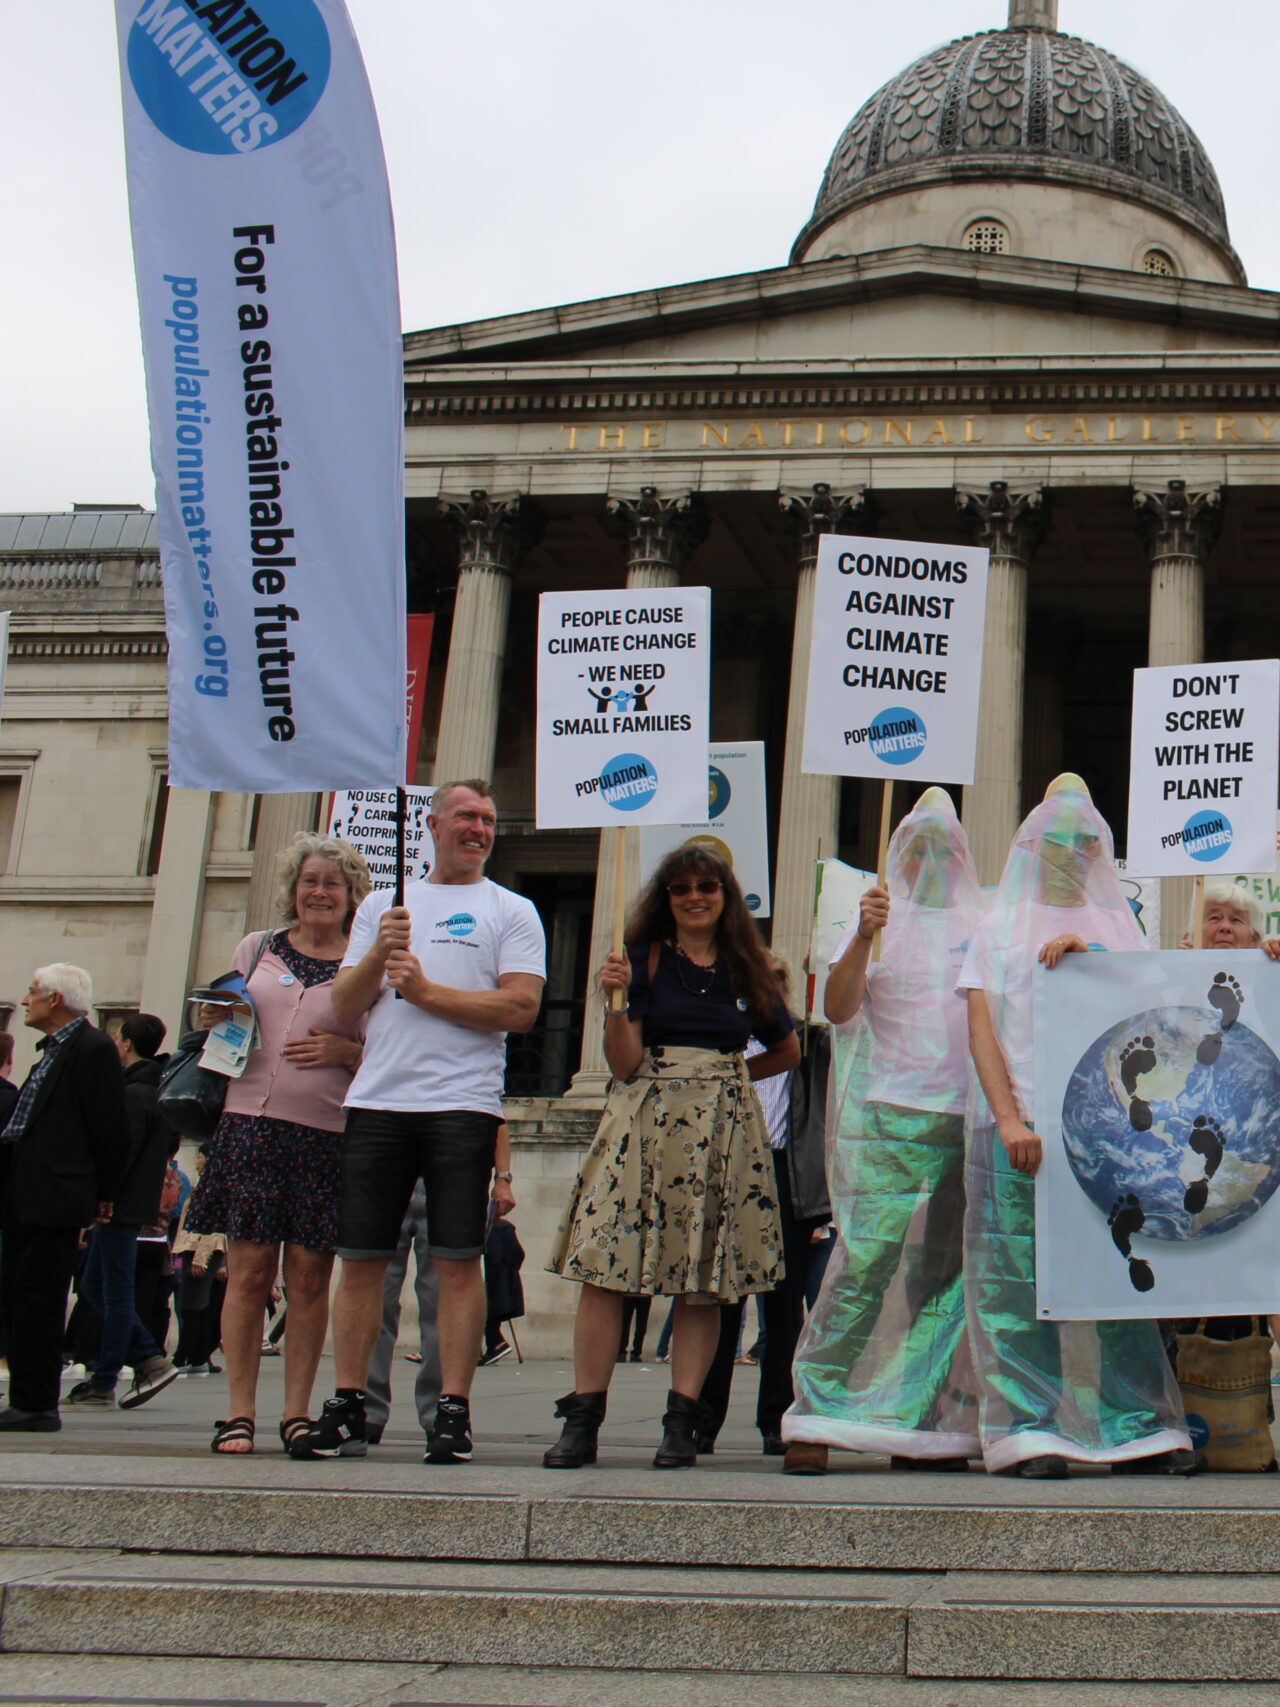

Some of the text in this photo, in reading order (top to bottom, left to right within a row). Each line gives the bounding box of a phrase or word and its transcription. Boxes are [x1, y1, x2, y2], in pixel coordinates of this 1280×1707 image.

[560, 416, 1280, 450] THE NATIONAL GALLERY
[163, 274, 229, 697] populationmatters.org
[233, 224, 299, 742] For a sustainable future
[838, 552, 967, 584] CONDOMS
[846, 590, 954, 619] AGAINST
[561, 608, 683, 628] PEOPLE CAUSE
[548, 633, 697, 655] CLIMATE CHANGE
[846, 627, 948, 656] CLIMATE
[588, 665, 616, 682] WE
[620, 663, 665, 681] NEED
[843, 665, 947, 693] CHANGE
[1173, 674, 1239, 698] DON'T
[552, 714, 692, 736] SMALL FAMILIES
[844, 718, 917, 745] POPULATION
[1165, 708, 1244, 732] SCREW
[872, 731, 925, 755] MATTERS
[1155, 742, 1253, 766] WITH THE
[575, 763, 648, 797] POPULATION
[602, 775, 658, 803] MATTERS
[1163, 777, 1243, 800] PLANET
[347, 791, 364, 801] NO
[365, 791, 386, 803] USE
[347, 825, 424, 841] FOOTPRINS IF
[1161, 818, 1224, 848] POPULATION
[1184, 829, 1232, 855] MATTERS
[365, 844, 419, 859] INCRESE
